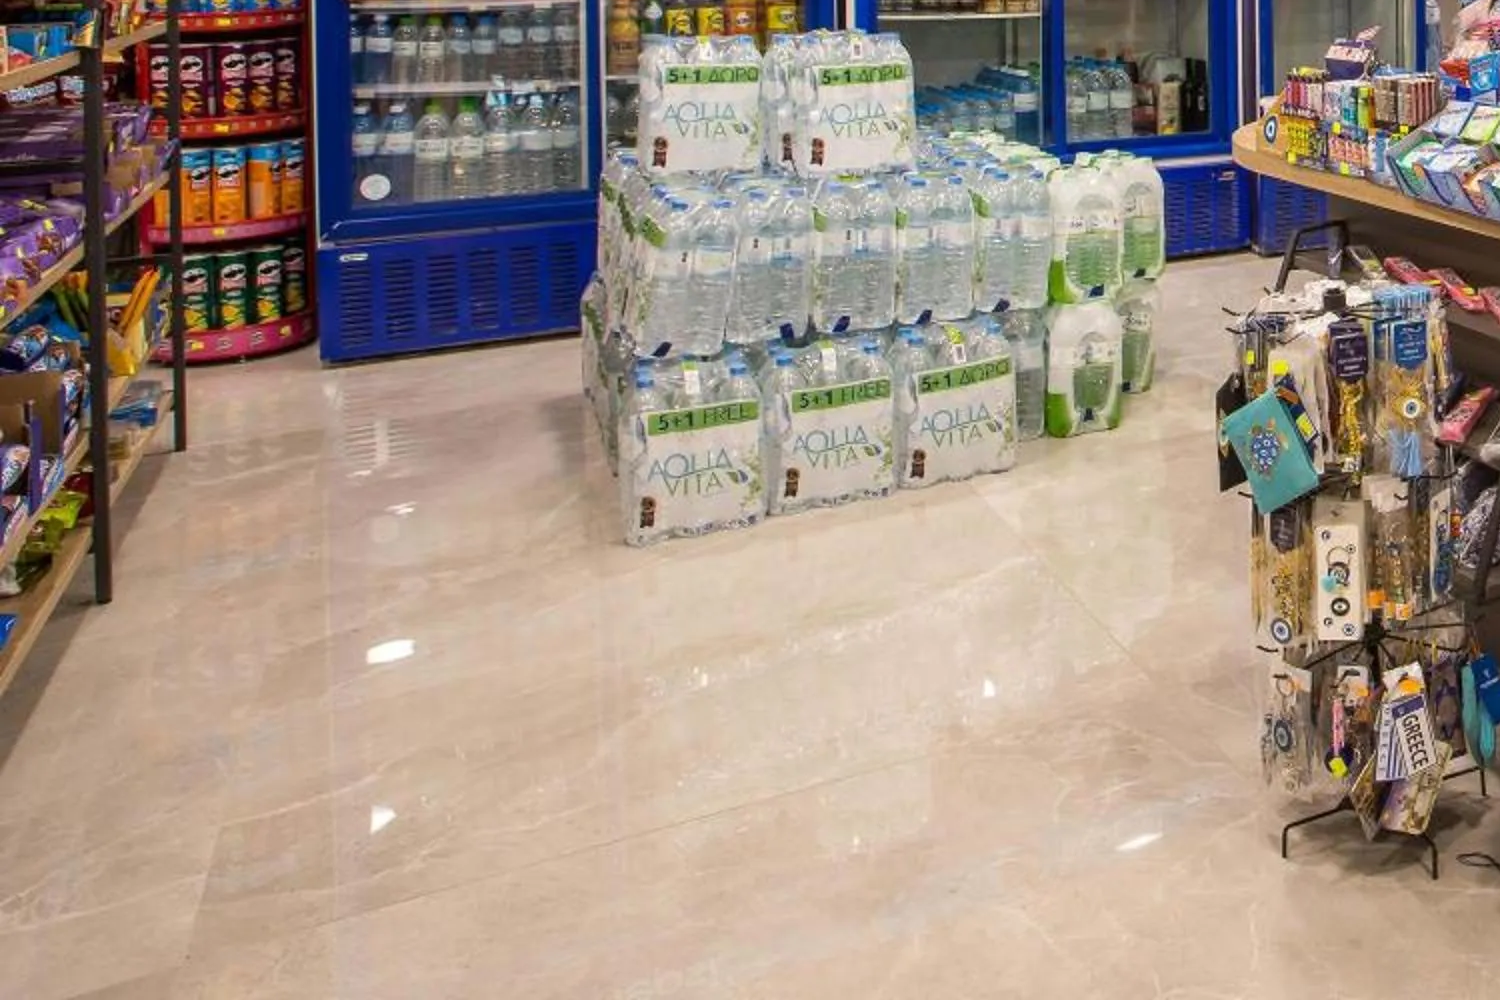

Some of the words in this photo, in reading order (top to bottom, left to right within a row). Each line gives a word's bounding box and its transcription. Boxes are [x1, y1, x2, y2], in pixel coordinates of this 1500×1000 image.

[668, 67, 700, 83] 5+1
[822, 68, 852, 85] 5+1
[663, 102, 737, 123] AQUA
[678, 121, 728, 138] VITA
[831, 120, 881, 138] VITA
[919, 372, 952, 392] 5+1
[799, 390, 834, 409] 5+1
[658, 411, 694, 432] 5+1
[920, 402, 991, 434] AQUA
[793, 425, 869, 454] AQUA
[931, 423, 983, 448] VITA
[647, 448, 734, 483] AQUA
[806, 446, 859, 470] VITA
[664, 471, 724, 498] VITA
[1403, 714, 1429, 770] GREECE
